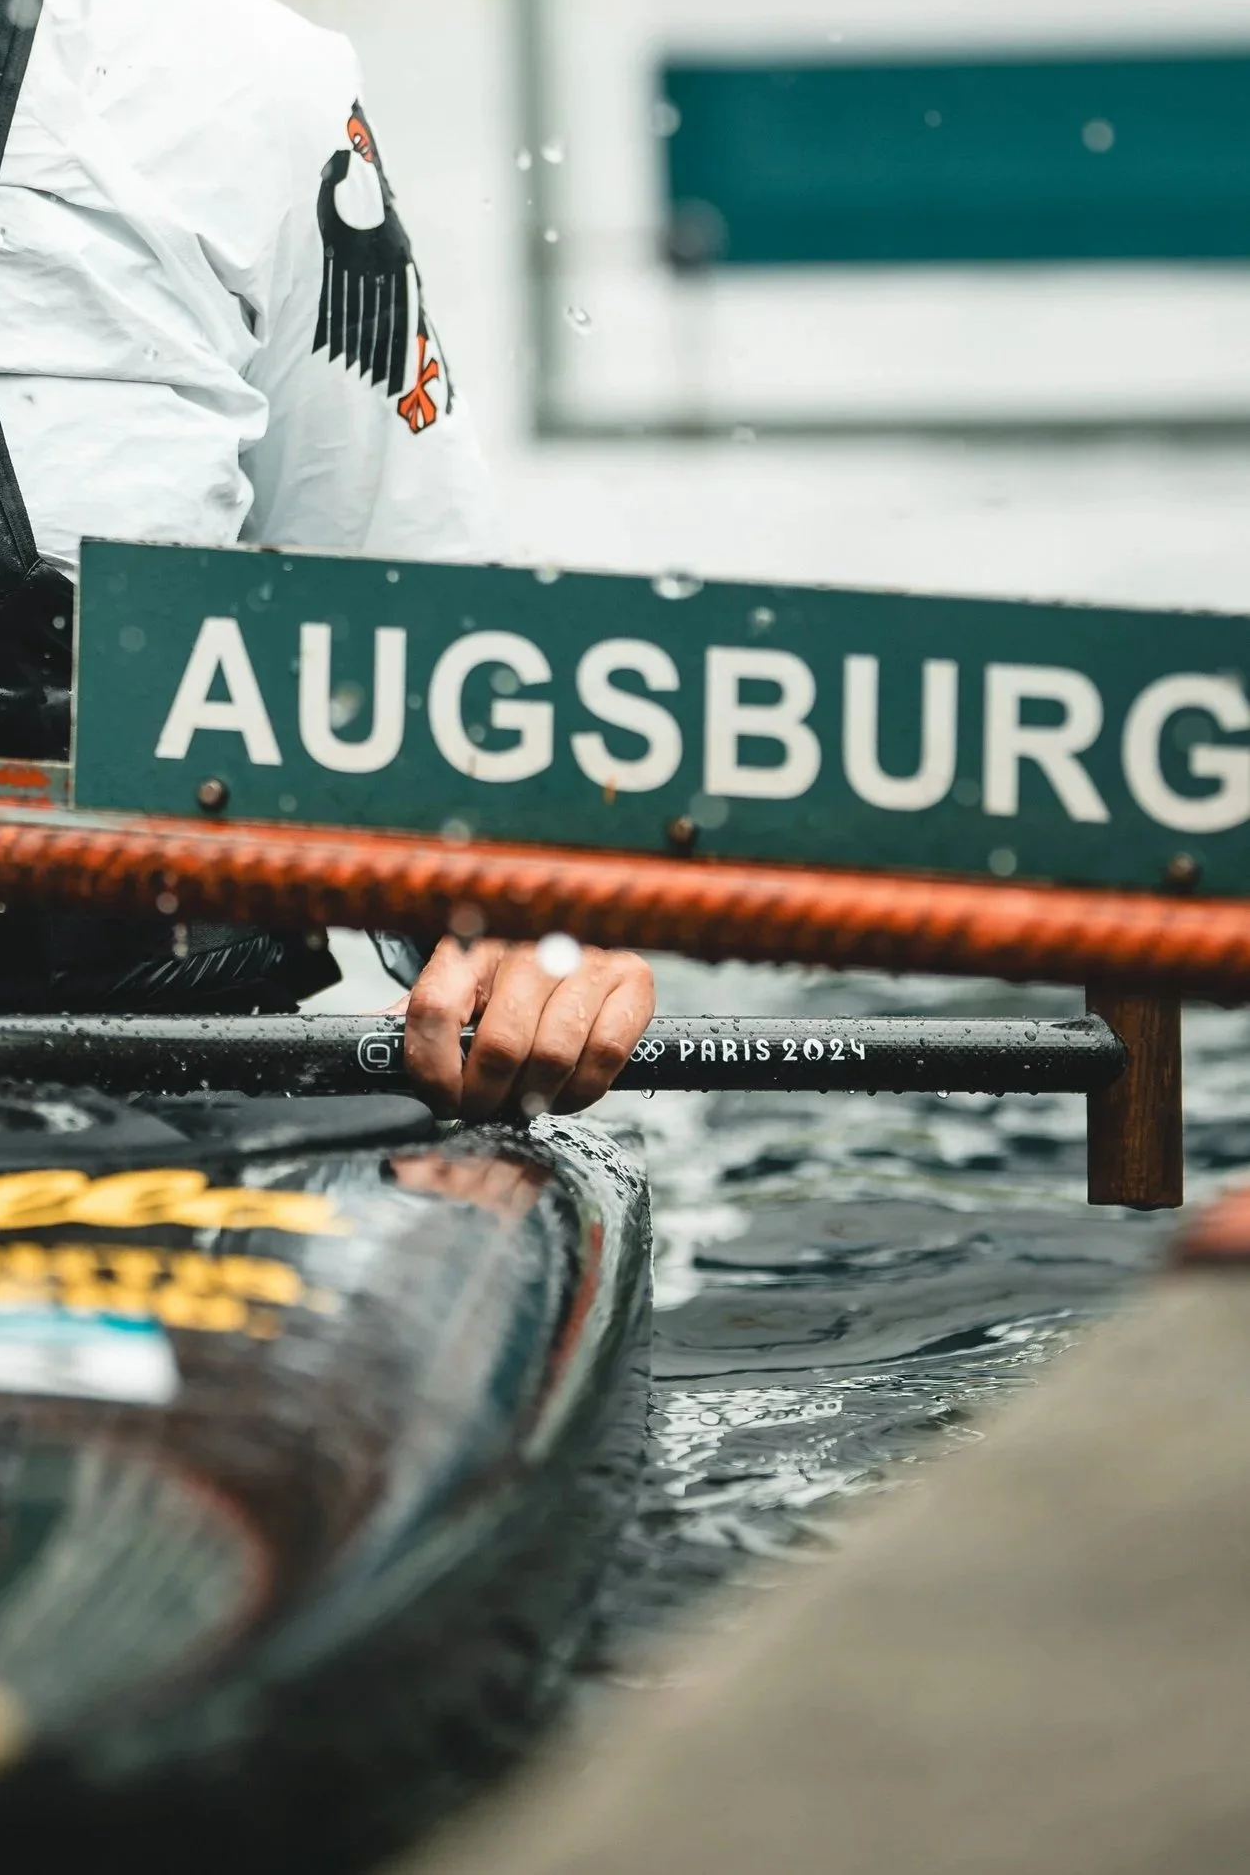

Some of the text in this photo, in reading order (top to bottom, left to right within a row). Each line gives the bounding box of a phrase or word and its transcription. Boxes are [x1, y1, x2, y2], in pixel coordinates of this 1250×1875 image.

[154, 615, 1250, 833] AUGSBURG
[679, 1038, 866, 1062] PARIS 2024
